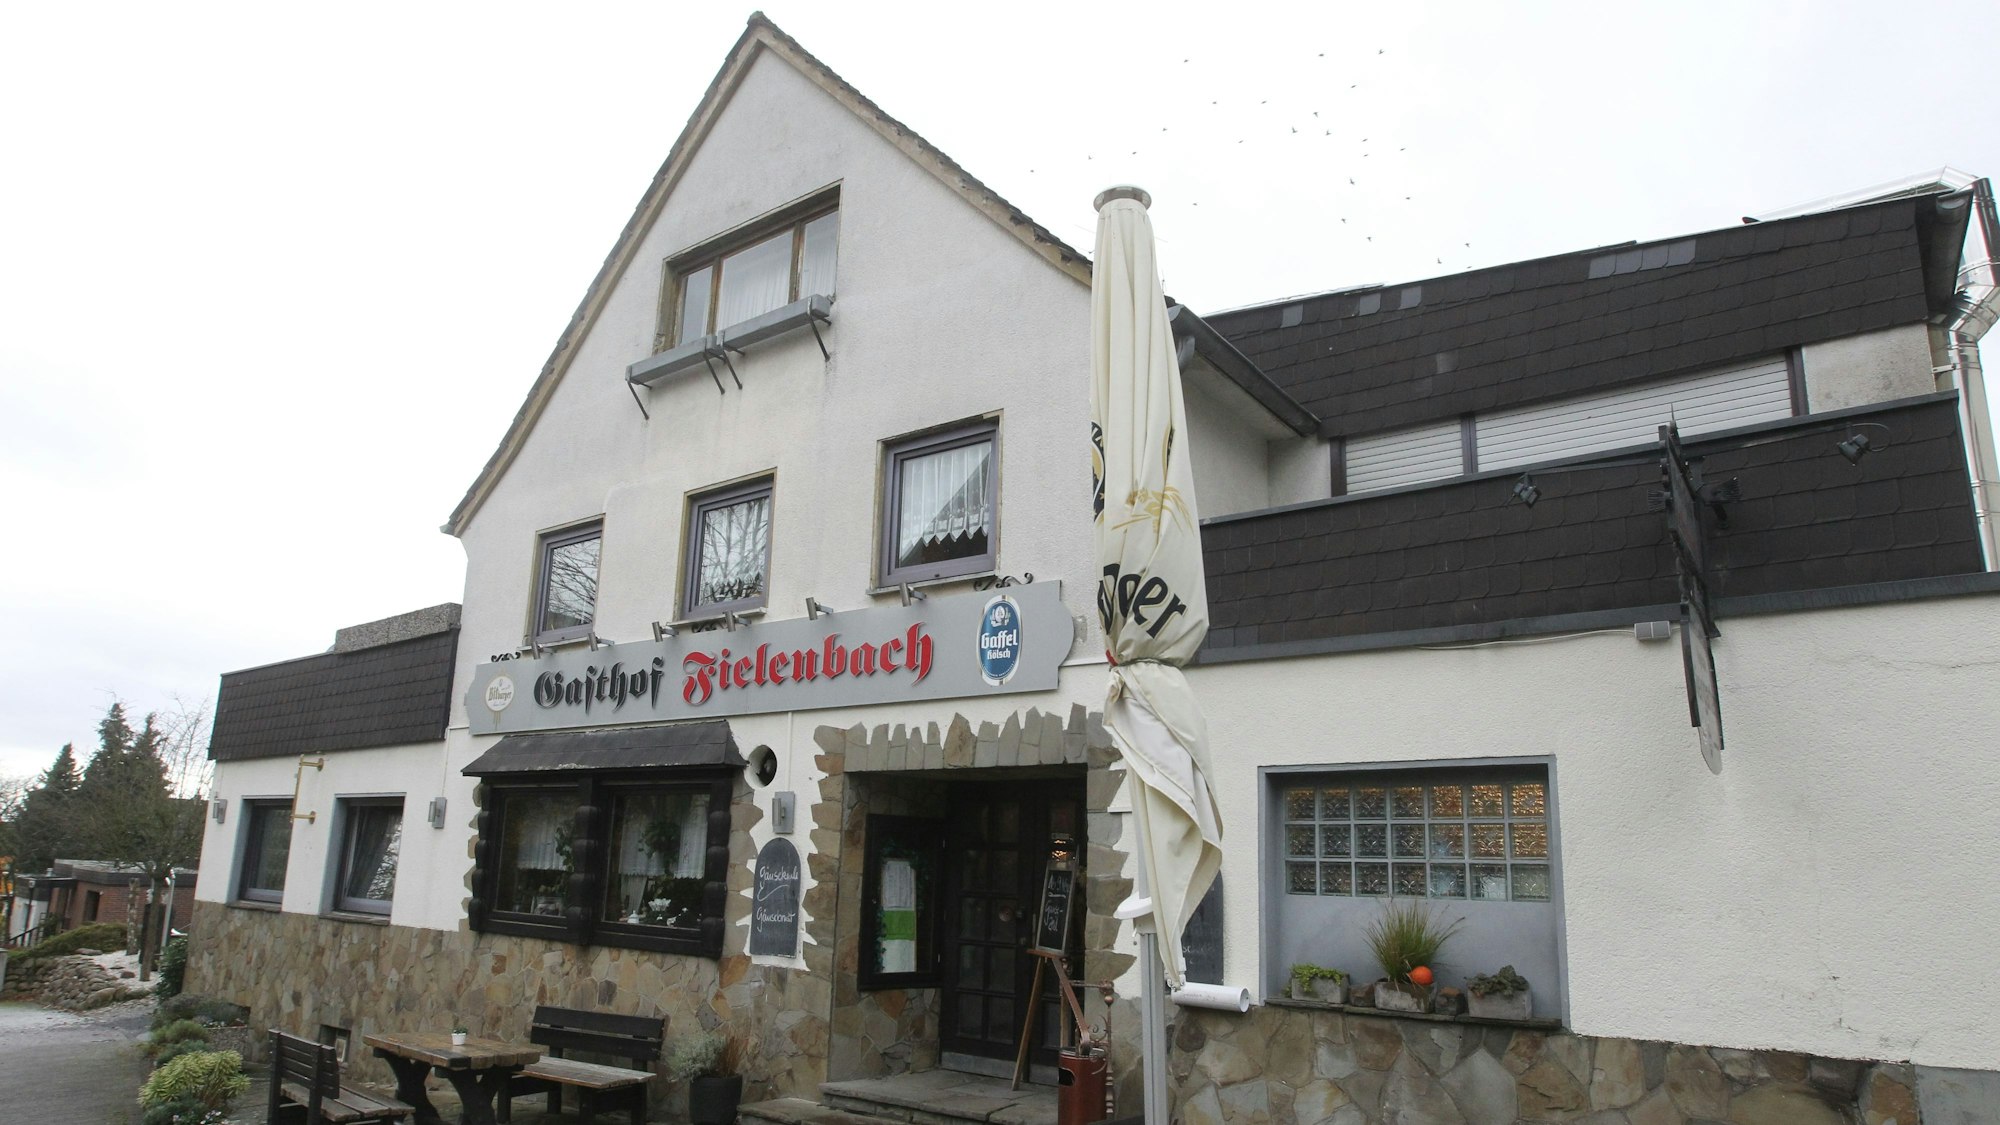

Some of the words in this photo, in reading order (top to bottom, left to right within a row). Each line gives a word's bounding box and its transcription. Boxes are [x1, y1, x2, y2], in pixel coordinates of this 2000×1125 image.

[981, 629, 1018, 649] Gaffel
[987, 648, 1011, 660] Kölsch
[533, 656, 665, 716] Gasthof
[682, 621, 934, 707] Fielenbach
